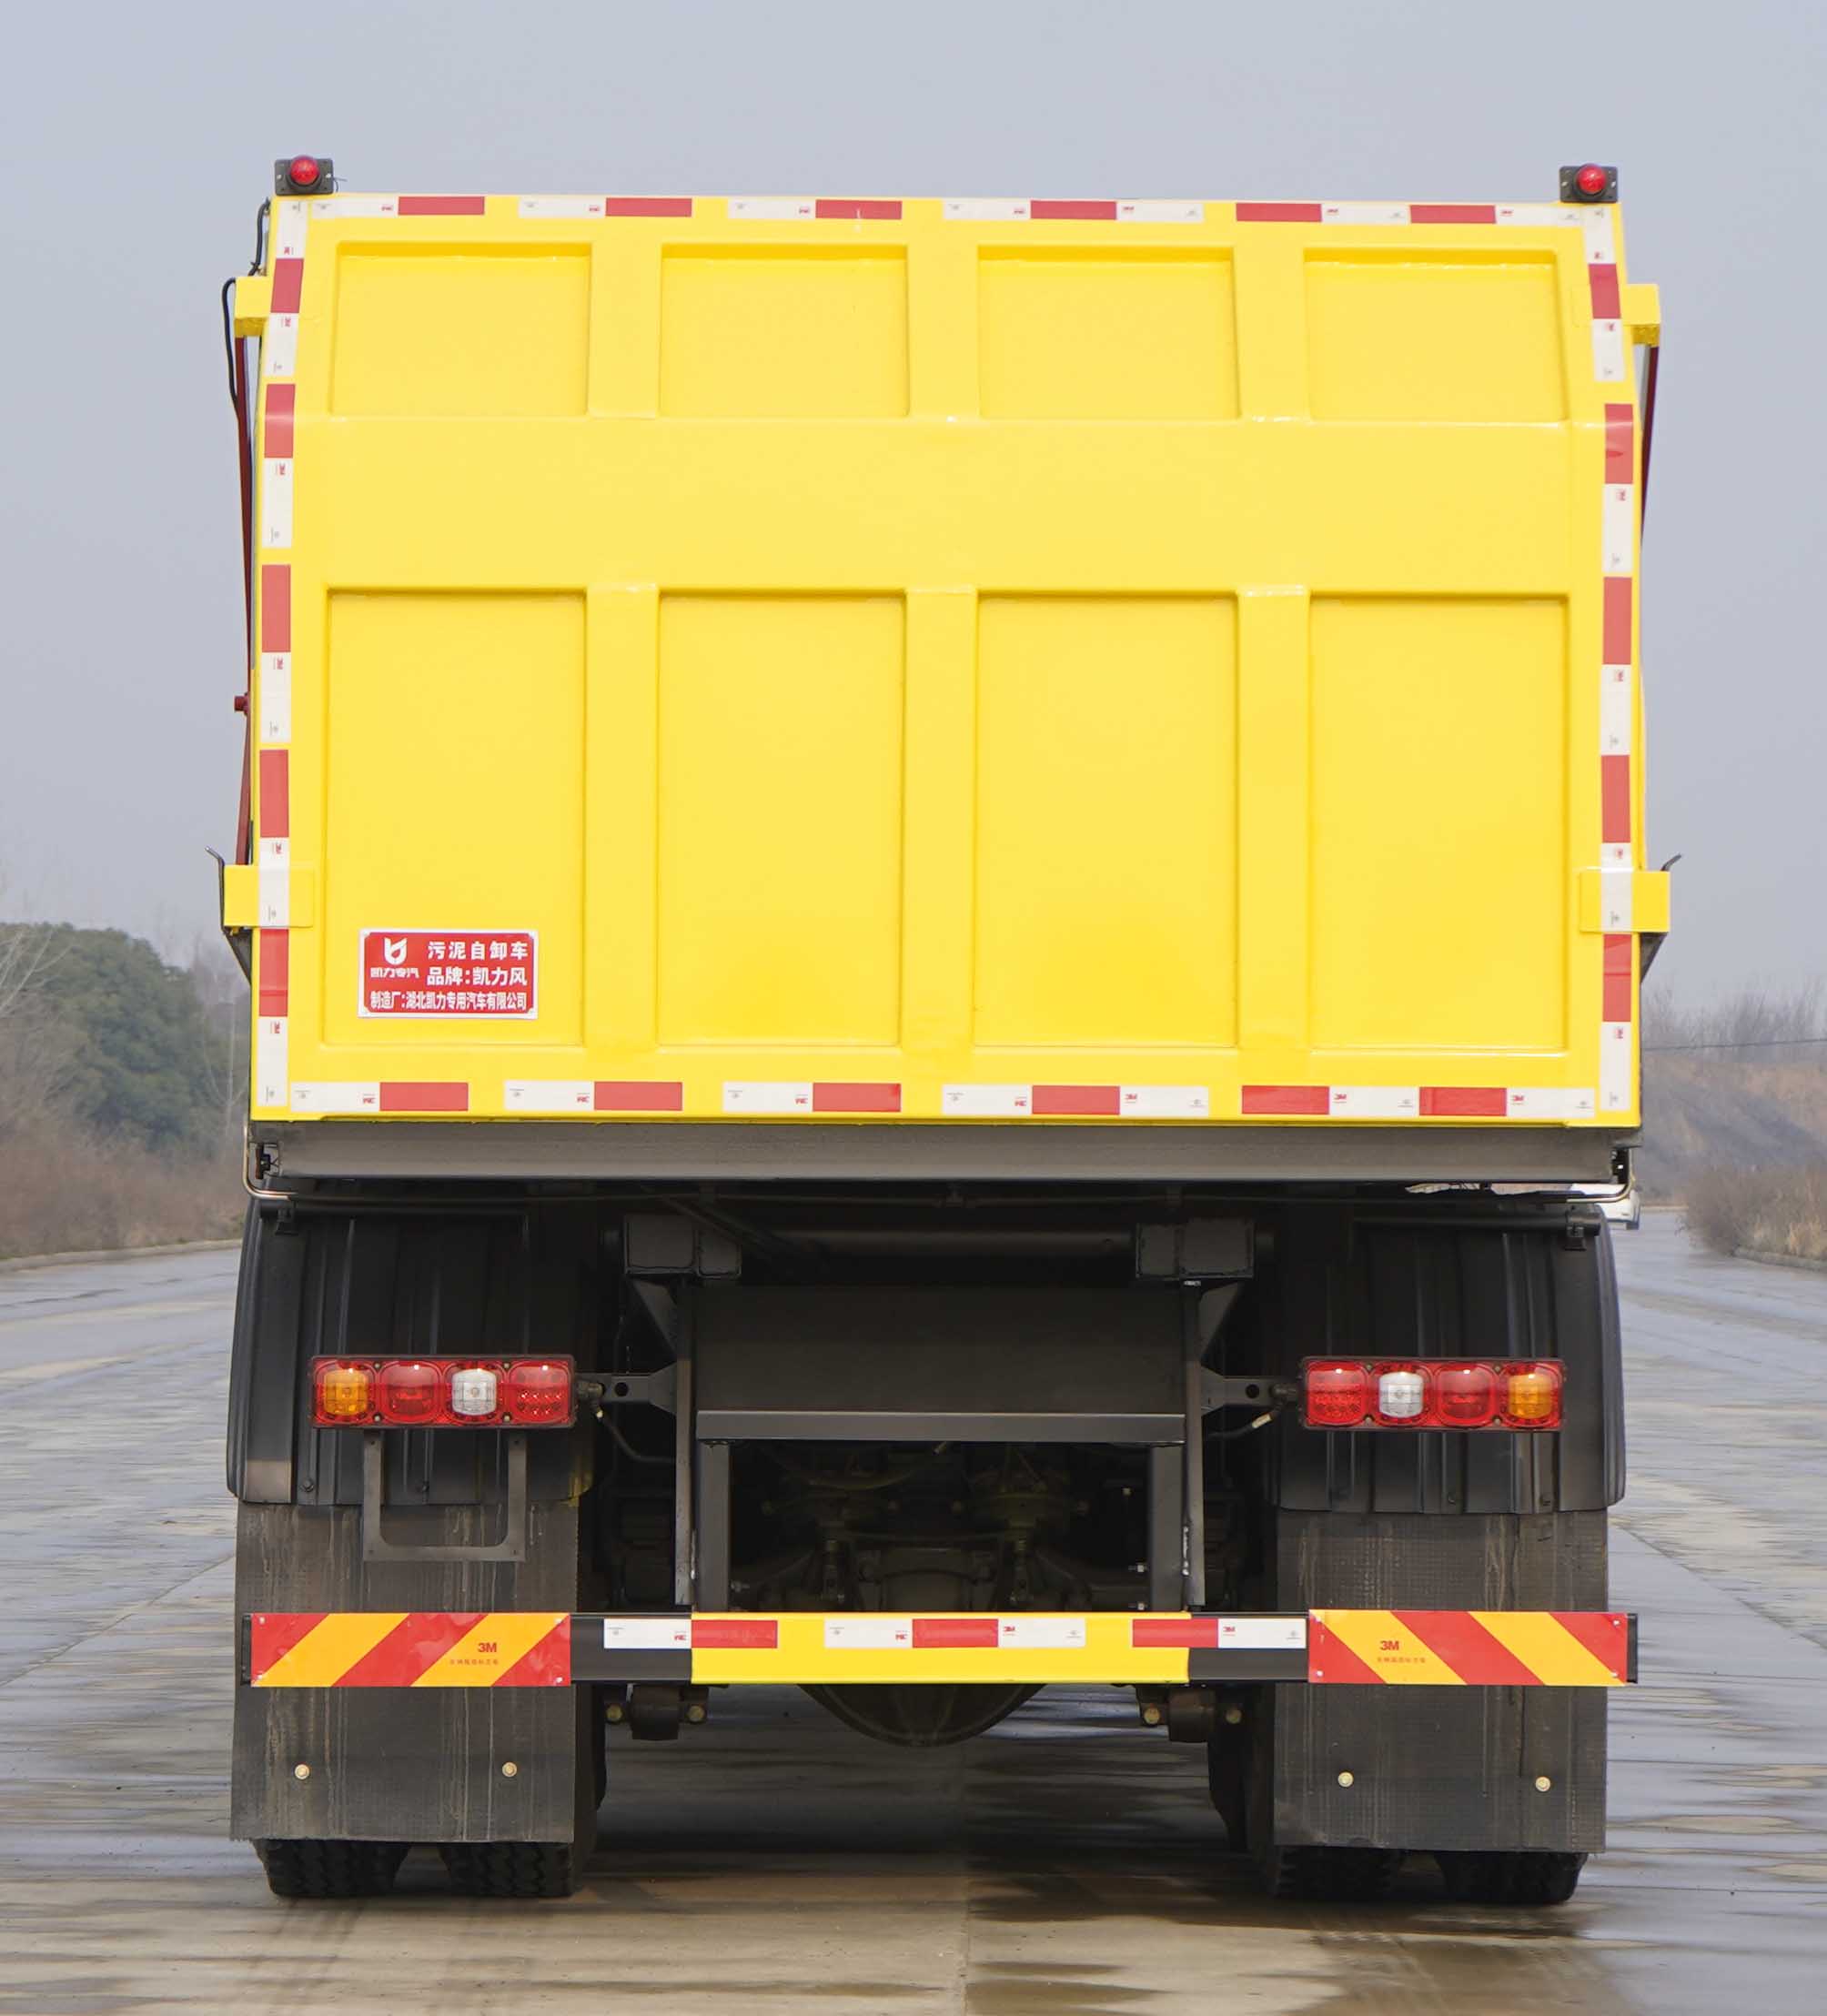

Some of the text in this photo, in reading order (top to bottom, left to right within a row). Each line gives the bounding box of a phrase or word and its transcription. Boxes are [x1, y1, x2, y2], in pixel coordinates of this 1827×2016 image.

[428, 941, 529, 960] 污泥自卸车
[427, 966, 528, 985] 品牌:凯力风
[478, 1642, 497, 1653] 3M
[1380, 1640, 1399, 1651] 3M
